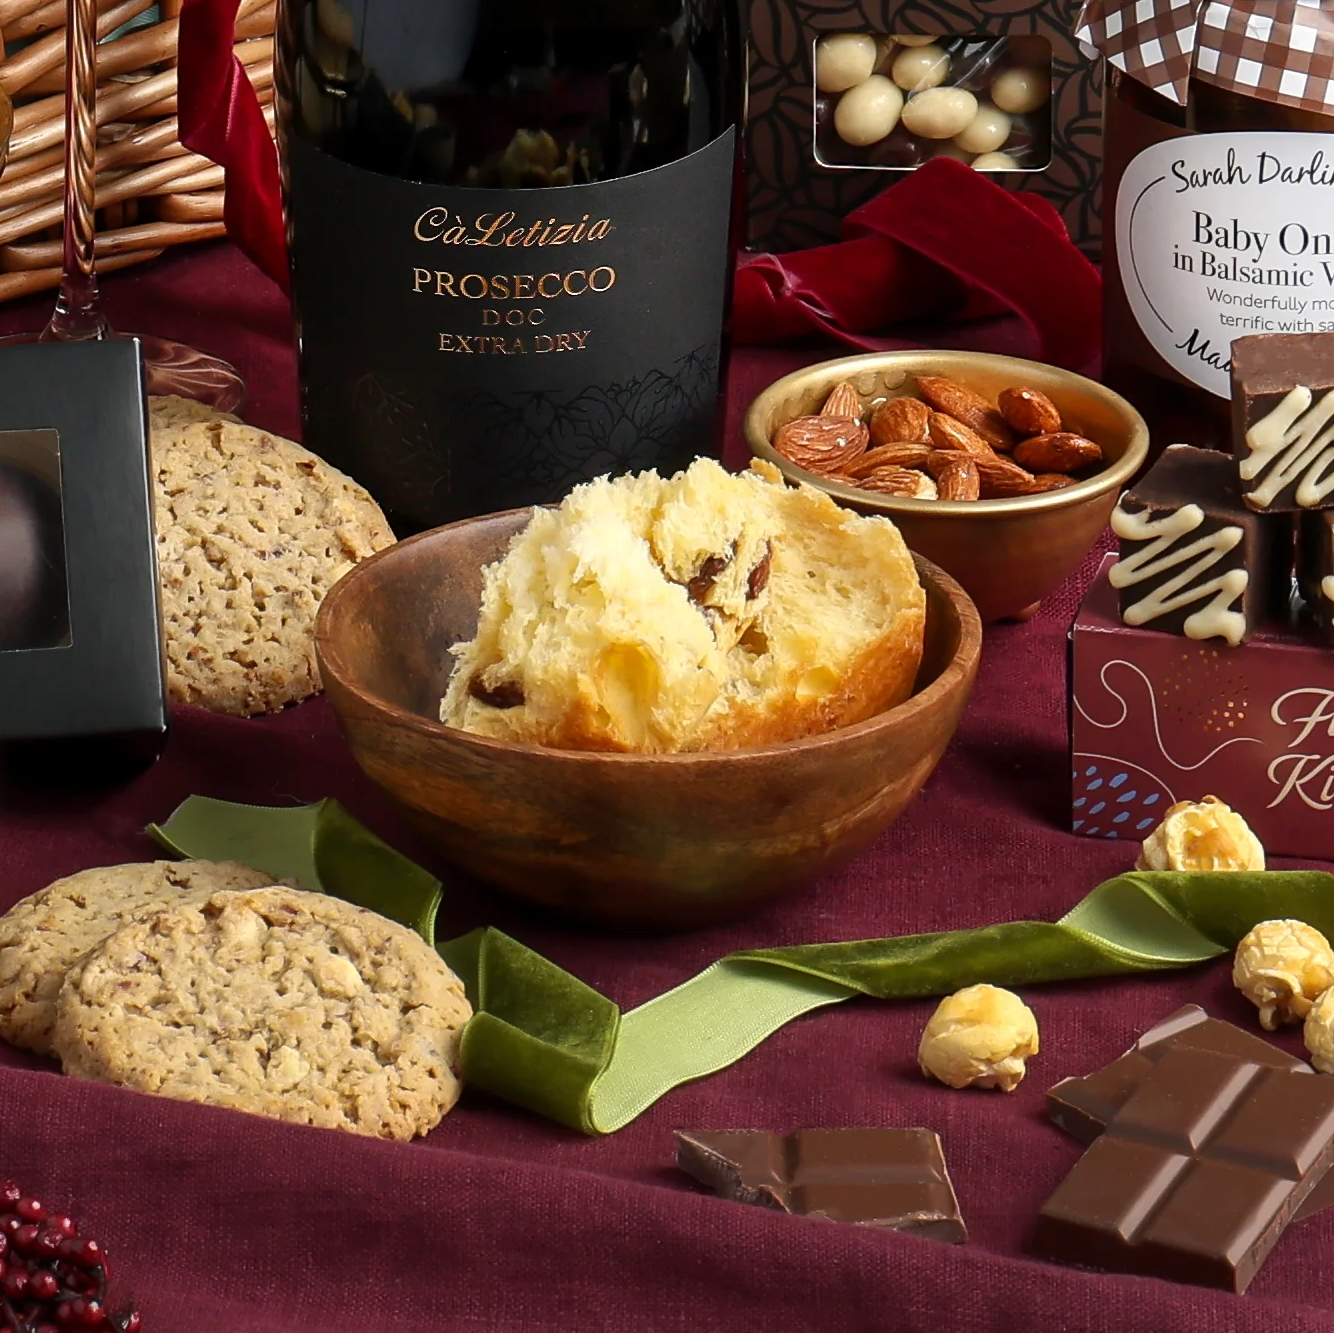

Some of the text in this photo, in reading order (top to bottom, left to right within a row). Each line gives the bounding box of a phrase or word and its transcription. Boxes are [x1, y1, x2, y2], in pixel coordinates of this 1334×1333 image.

[1171, 147, 1251, 193] Sarah
[1192, 210, 1270, 263] Baby
[1172, 245, 1194, 273] in
[1200, 251, 1314, 287] Balsamic
[412, 266, 616, 300] PROSECCO
[1206, 287, 1308, 314] Wonderfully
[482, 308, 546, 326] DOC
[1219, 312, 1274, 330] terrific
[1278, 317, 1314, 332] with
[439, 330, 591, 355] EXTRA DRY
